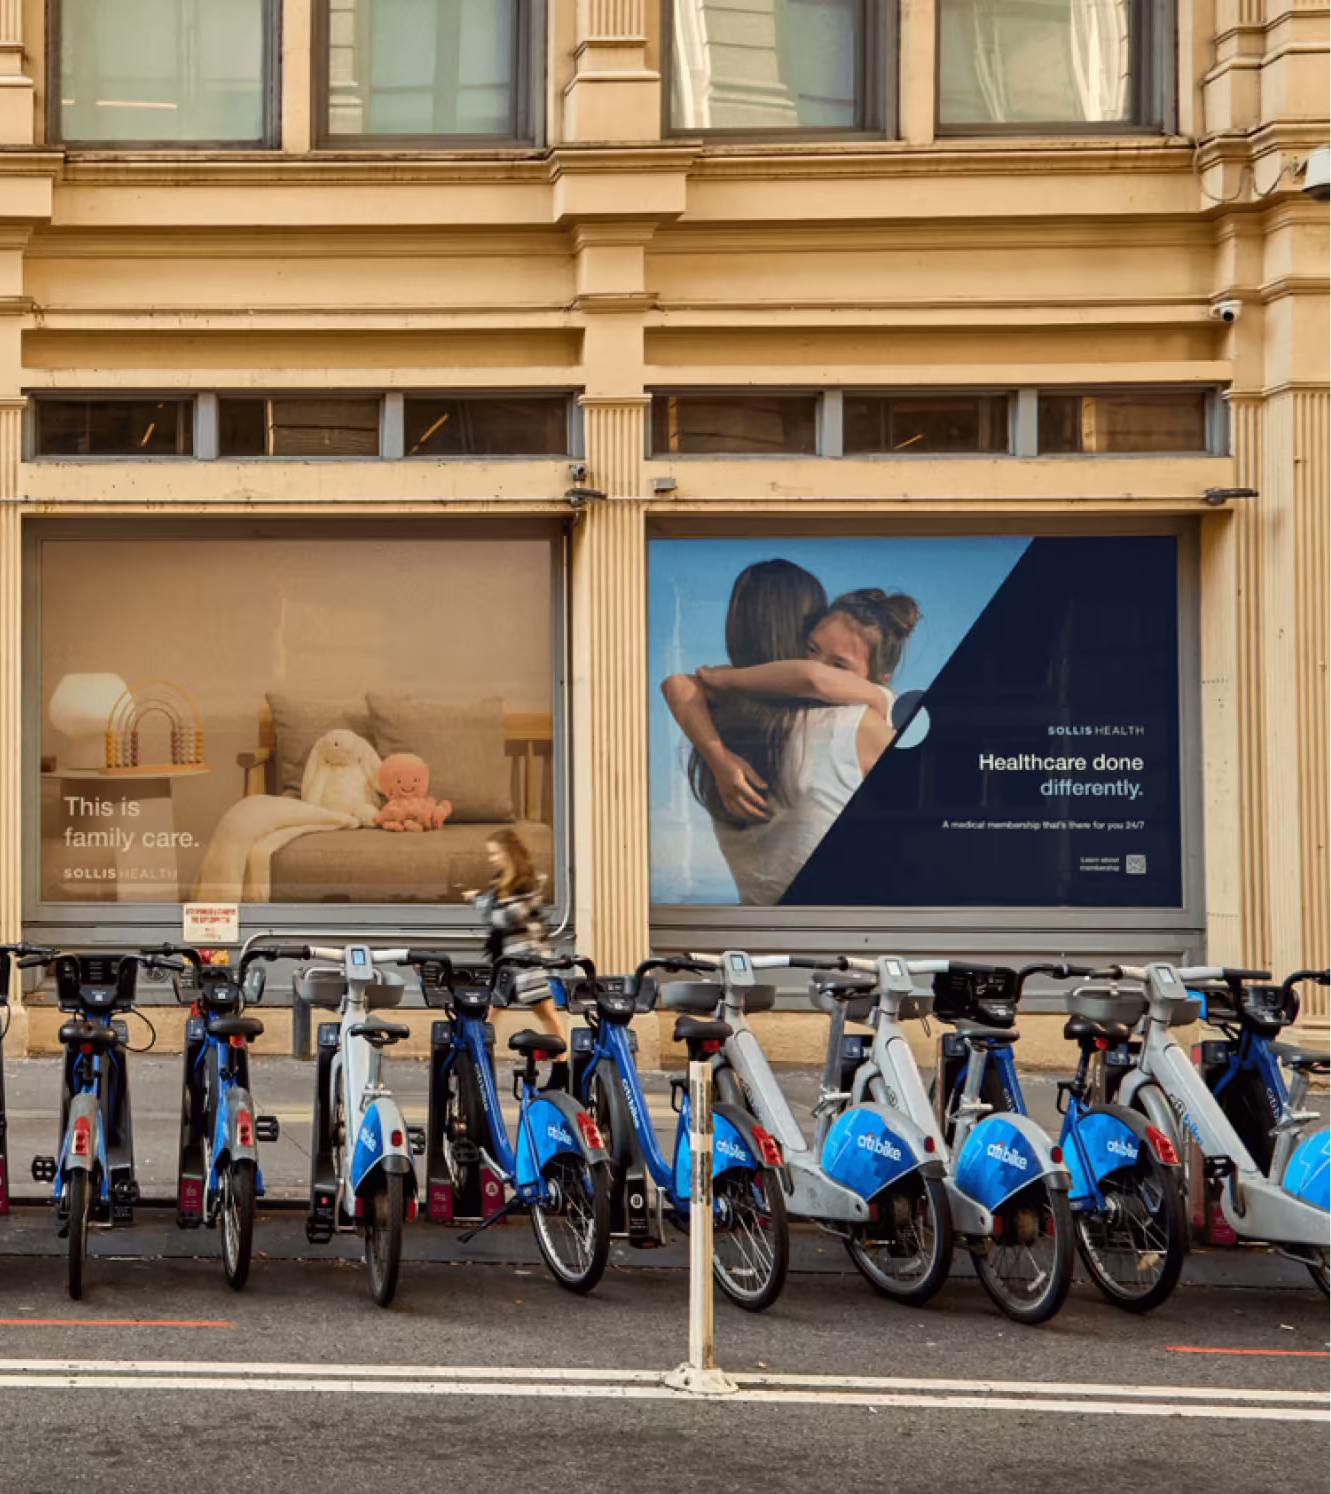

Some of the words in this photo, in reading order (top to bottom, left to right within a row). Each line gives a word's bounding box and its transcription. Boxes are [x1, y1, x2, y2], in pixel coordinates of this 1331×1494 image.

[1048, 726, 1092, 736] SOLLIS
[1095, 726, 1144, 736] HEALTH
[979, 754, 1086, 771] Healthcare
[1092, 754, 1144, 771] done
[1040, 779, 1143, 800] differently.
[64, 796, 113, 817] This
[121, 796, 141, 817] is
[942, 820, 950, 830] A
[951, 820, 985, 830] medical
[987, 820, 1041, 832] membership
[1042, 820, 1067, 830] that's
[1069, 820, 1091, 830] there
[1093, 820, 1105, 830] for
[1107, 822, 1124, 832] you
[1125, 820, 1145, 830] 24/7
[64, 827, 135, 852] family
[142, 830, 200, 848] care.
[63, 868, 117, 879] SOLLIS
[119, 868, 177, 879] HEALTH
